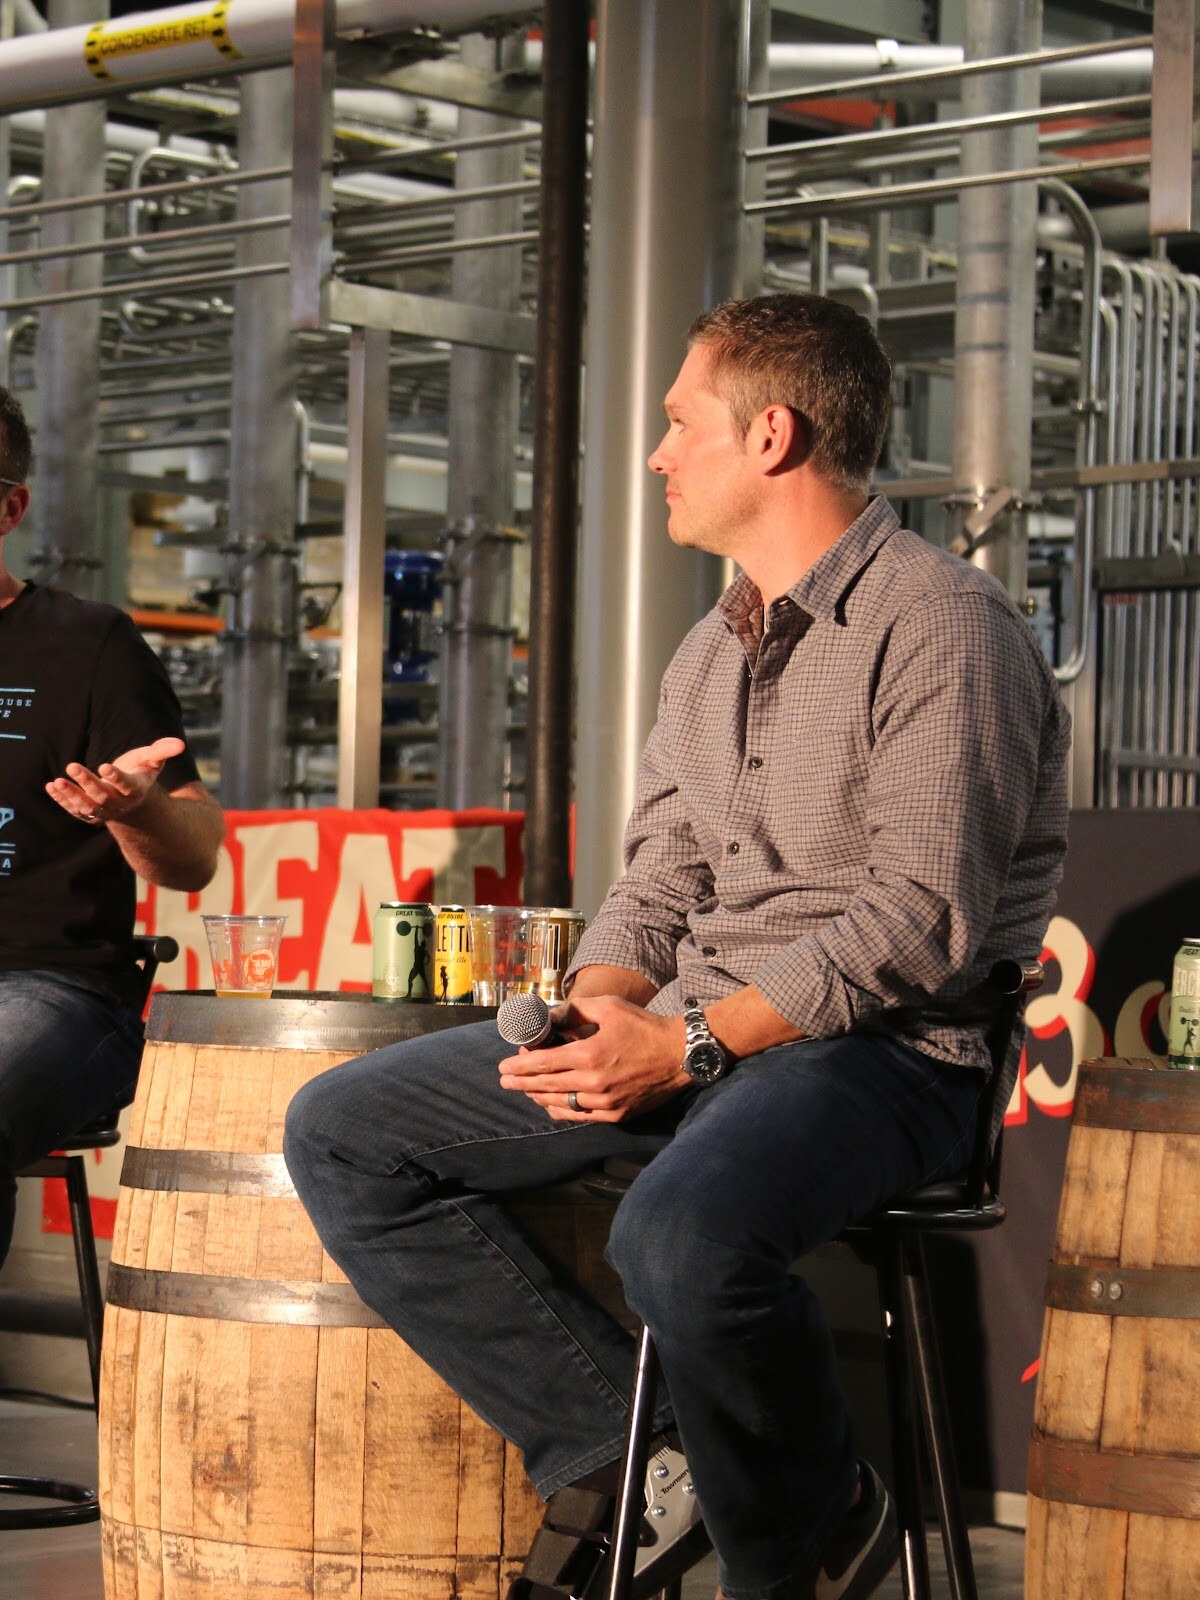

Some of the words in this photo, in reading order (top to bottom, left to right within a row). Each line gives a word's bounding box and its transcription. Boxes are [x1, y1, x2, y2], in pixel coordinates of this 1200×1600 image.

[101, 24, 181, 54] CONDENSATE
[136, 820, 506, 992] REAT
[661, 1468, 689, 1495] Townsen
